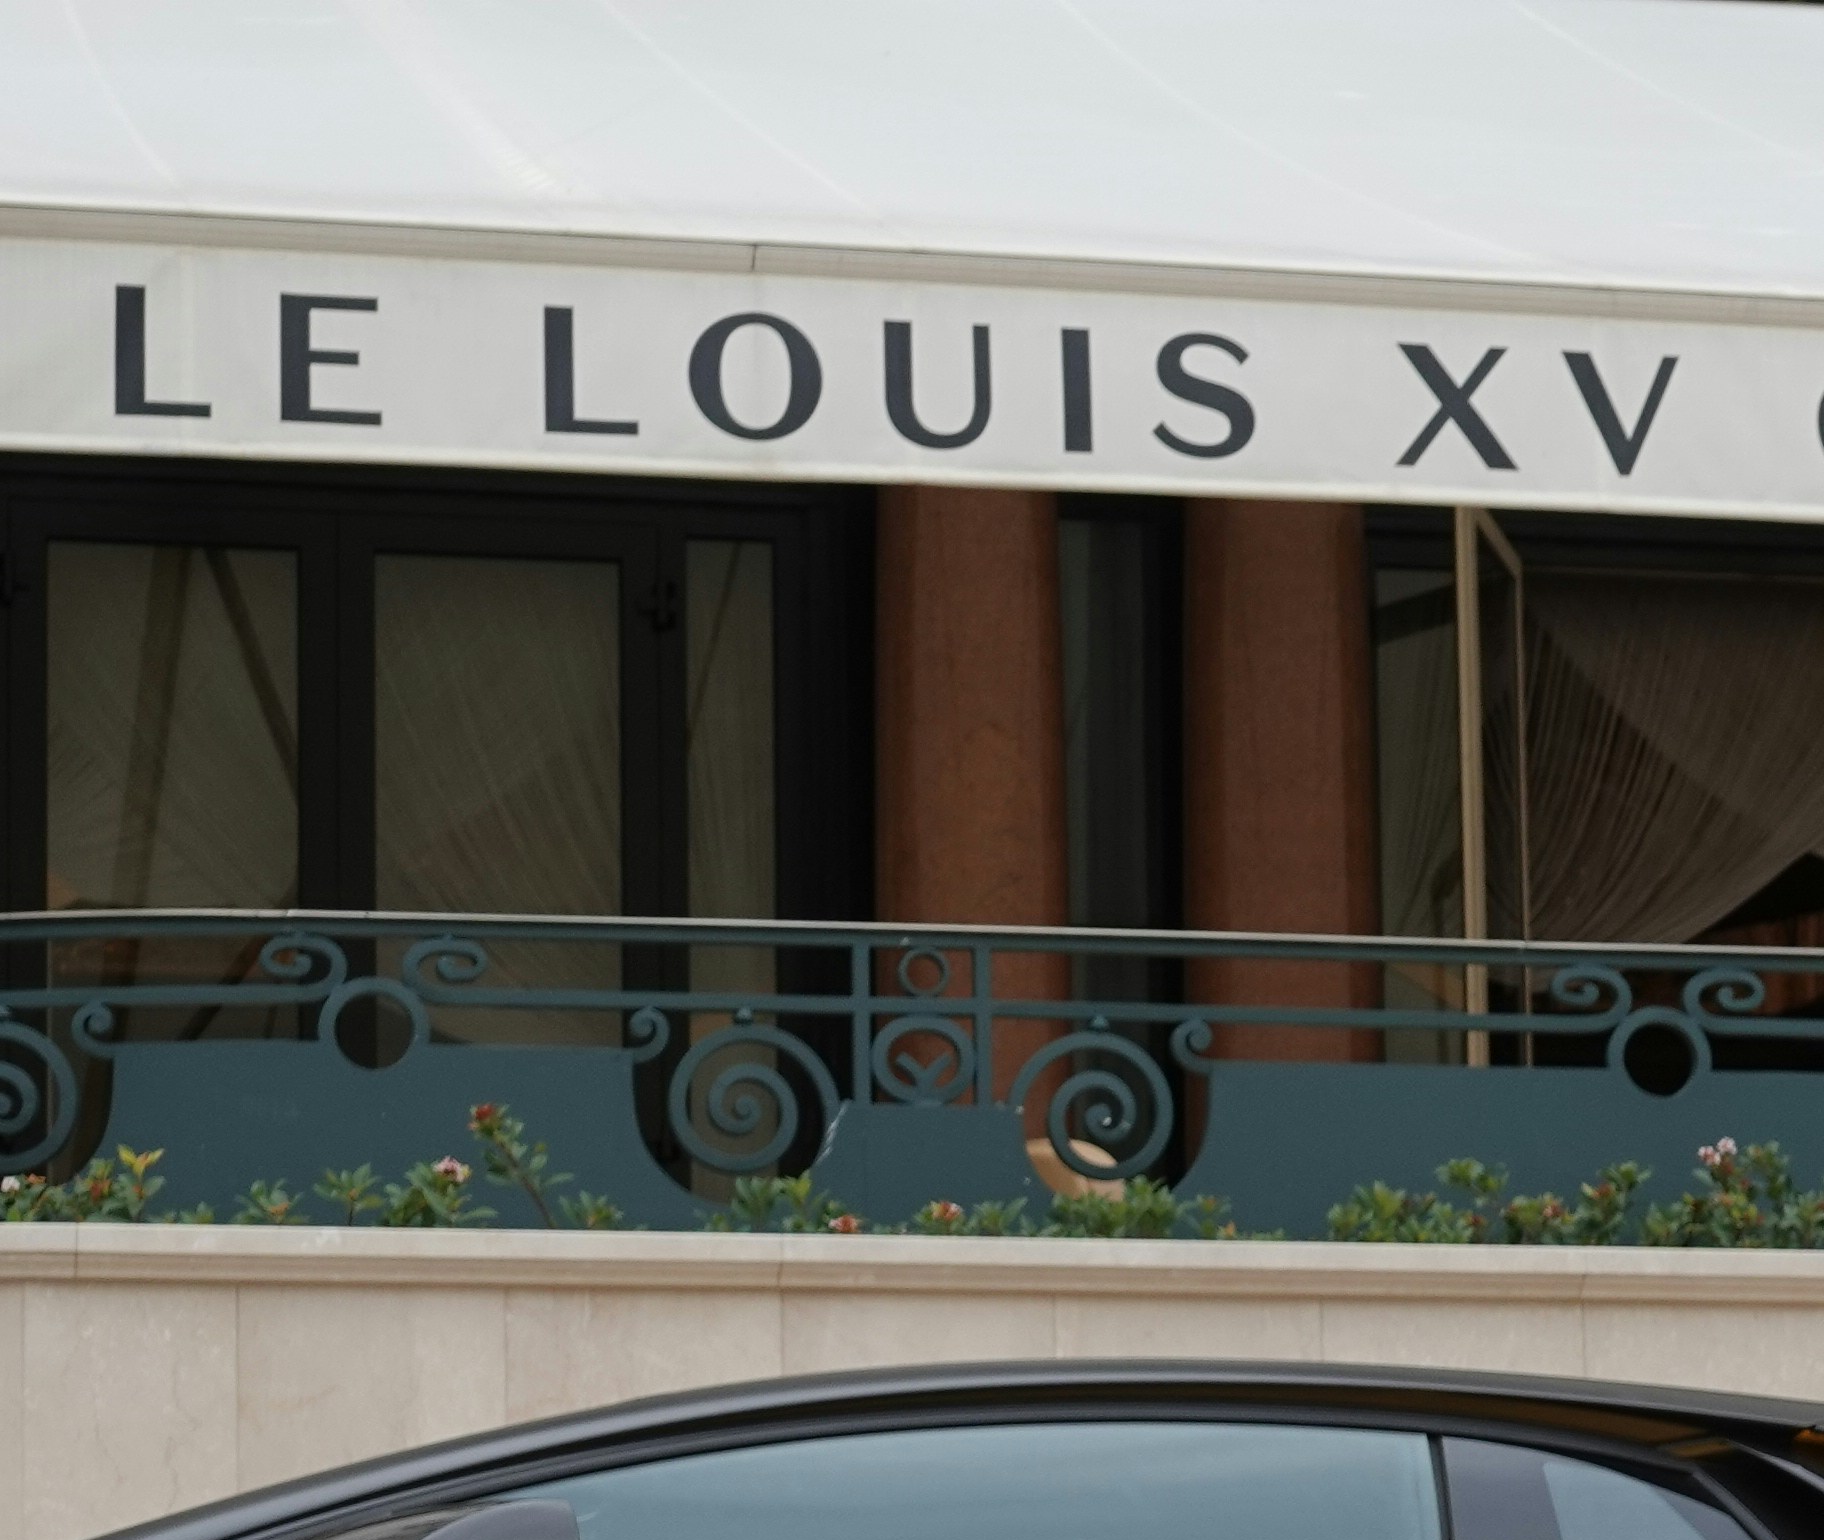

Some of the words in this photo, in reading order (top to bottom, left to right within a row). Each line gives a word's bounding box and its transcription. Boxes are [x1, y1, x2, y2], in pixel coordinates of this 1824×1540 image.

[113, 284, 383, 427] LE
[543, 305, 1256, 460] LOUIS
[1396, 342, 1679, 477] XV
